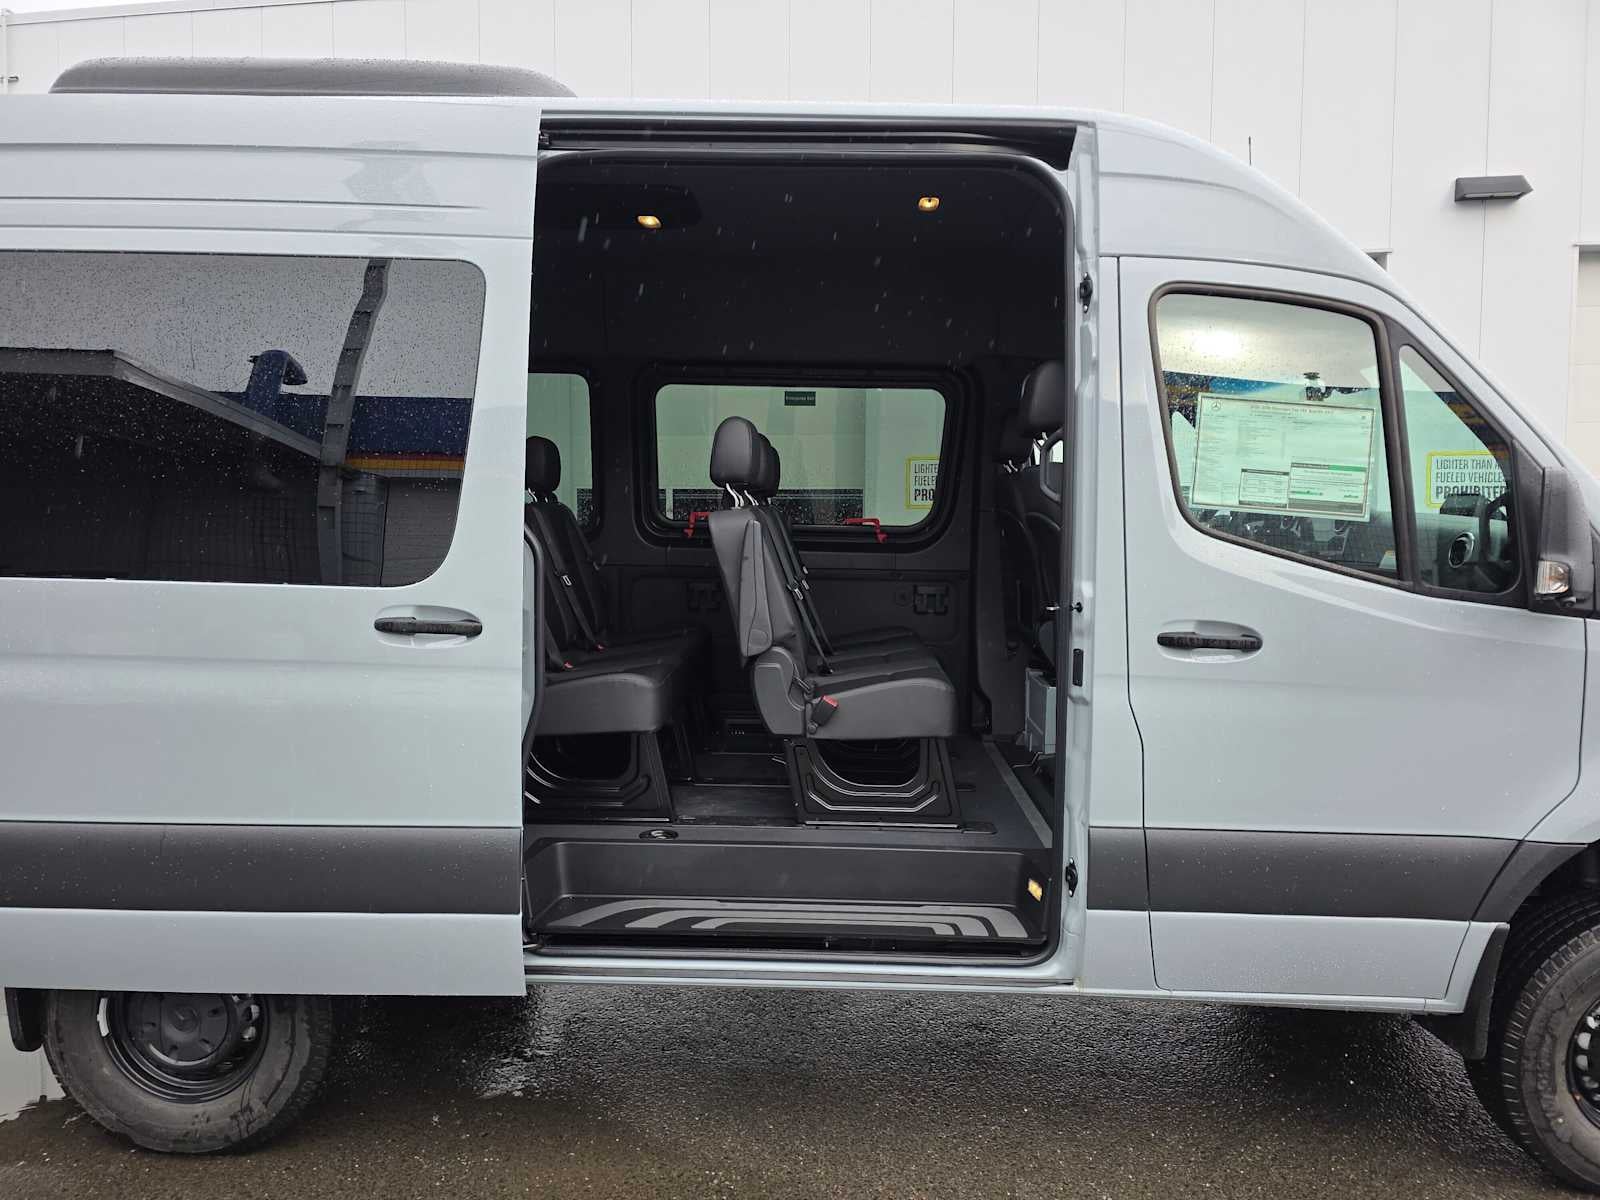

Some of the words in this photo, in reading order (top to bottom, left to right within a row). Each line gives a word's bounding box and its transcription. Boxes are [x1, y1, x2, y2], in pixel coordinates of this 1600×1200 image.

[1436, 459, 1469, 469] LIGHTER
[1471, 459, 1493, 469] THAN
[1436, 471, 1466, 483] FUELED
[1468, 471, 1506, 483] VEHICLE
